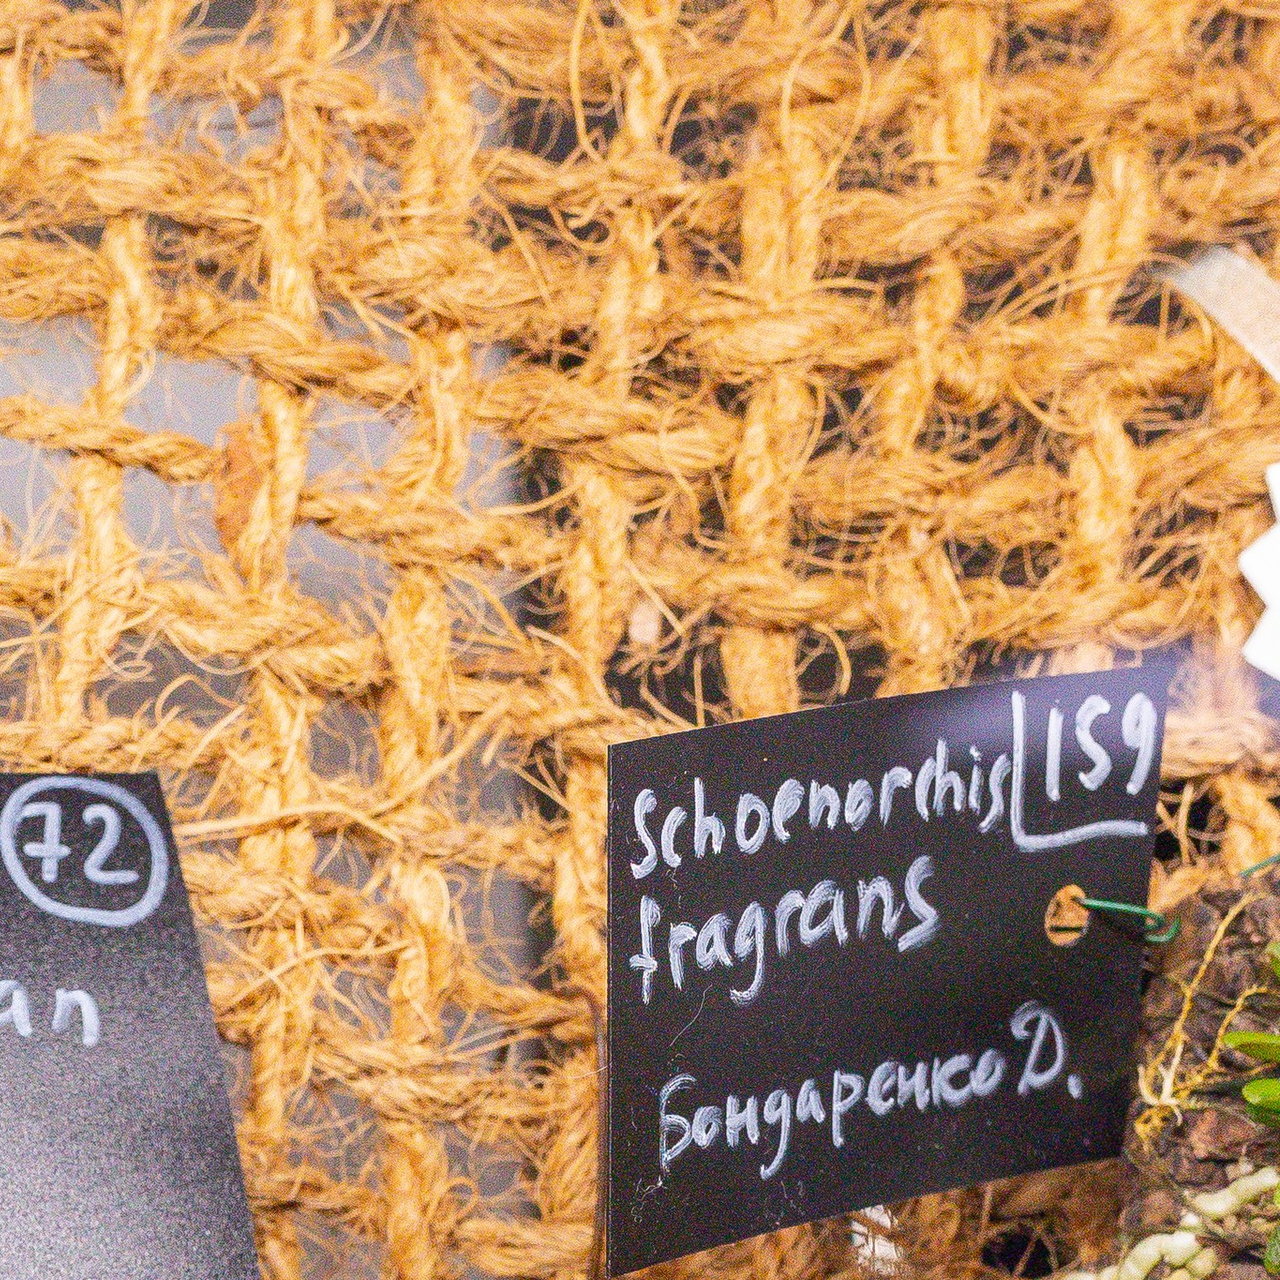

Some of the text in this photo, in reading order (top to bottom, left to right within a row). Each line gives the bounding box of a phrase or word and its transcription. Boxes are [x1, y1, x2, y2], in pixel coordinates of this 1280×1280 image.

[629, 738, 1012, 879] Schoenorchis
[1044, 691, 1158, 802] 159
[19, 801, 140, 887] 72
[629, 854, 939, 1005] fragrans
